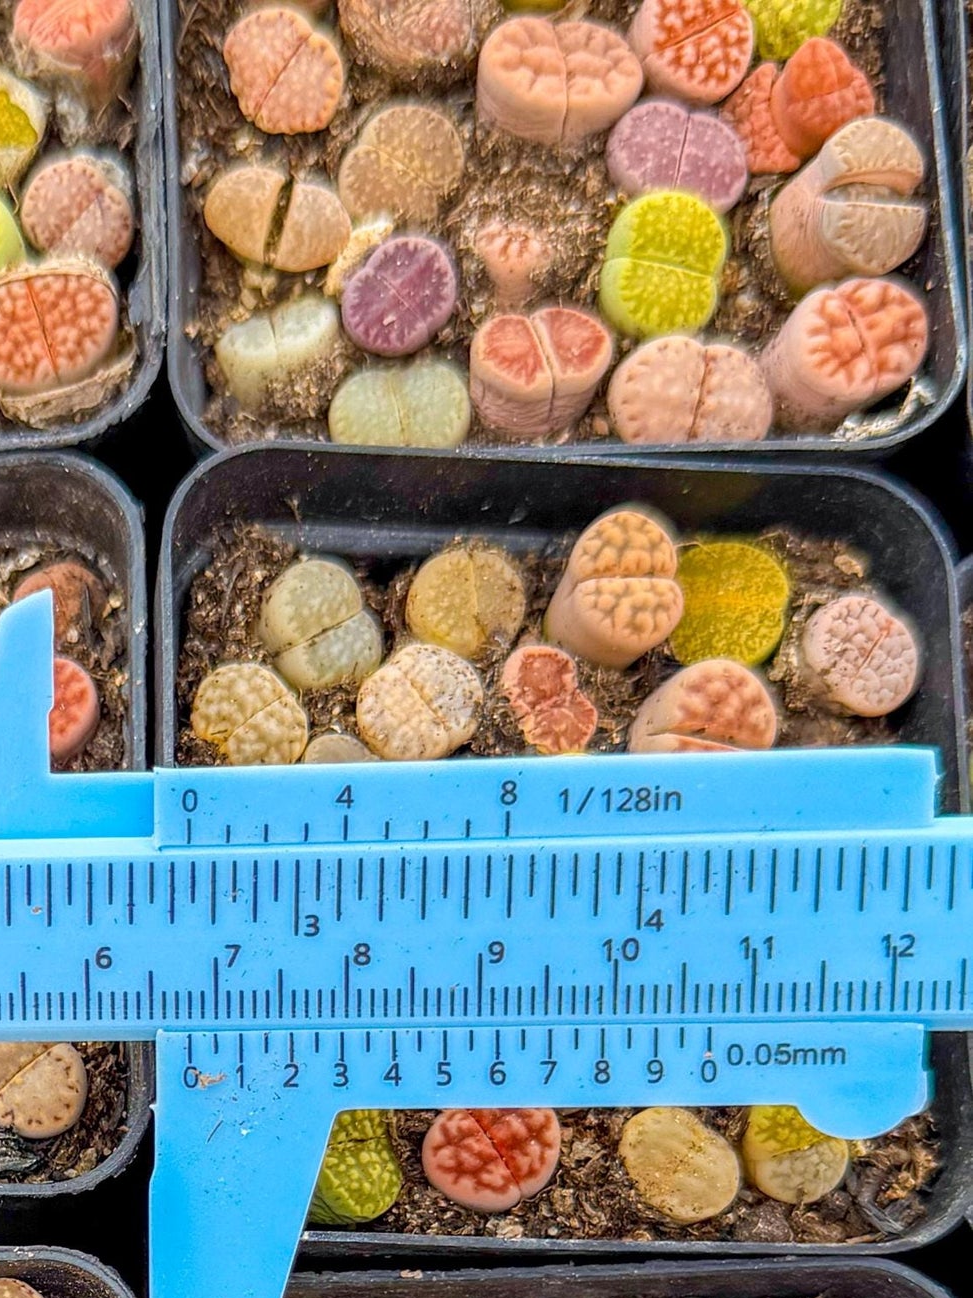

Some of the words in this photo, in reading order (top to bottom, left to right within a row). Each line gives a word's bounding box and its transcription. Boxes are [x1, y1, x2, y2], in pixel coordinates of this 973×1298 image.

[181, 788, 199, 814] 0
[335, 784, 355, 809] 4
[500, 779, 518, 805] 8
[558, 784, 683, 816] 1/128in
[303, 914, 321, 938] 3
[644, 908, 665, 933] 4
[94, 946, 113, 970] 6
[224, 943, 242, 968] 7
[353, 943, 372, 966] 8
[487, 940, 506, 965] 9
[602, 937, 641, 963] 10
[739, 935, 775, 960] 11
[882, 934, 917, 958] 12
[183, 1065, 199, 1089] 0
[283, 1063, 300, 1088] 2
[333, 1062, 349, 1088] 3
[382, 1062, 403, 1087] 4
[435, 1062, 453, 1087] 5
[489, 1061, 507, 1086] 6
[539, 1061, 557, 1086] 7
[593, 1060, 612, 1085] 8
[646, 1060, 664, 1085] 9
[700, 1060, 718, 1085] 0
[726, 1042, 847, 1067] 0.05mm
